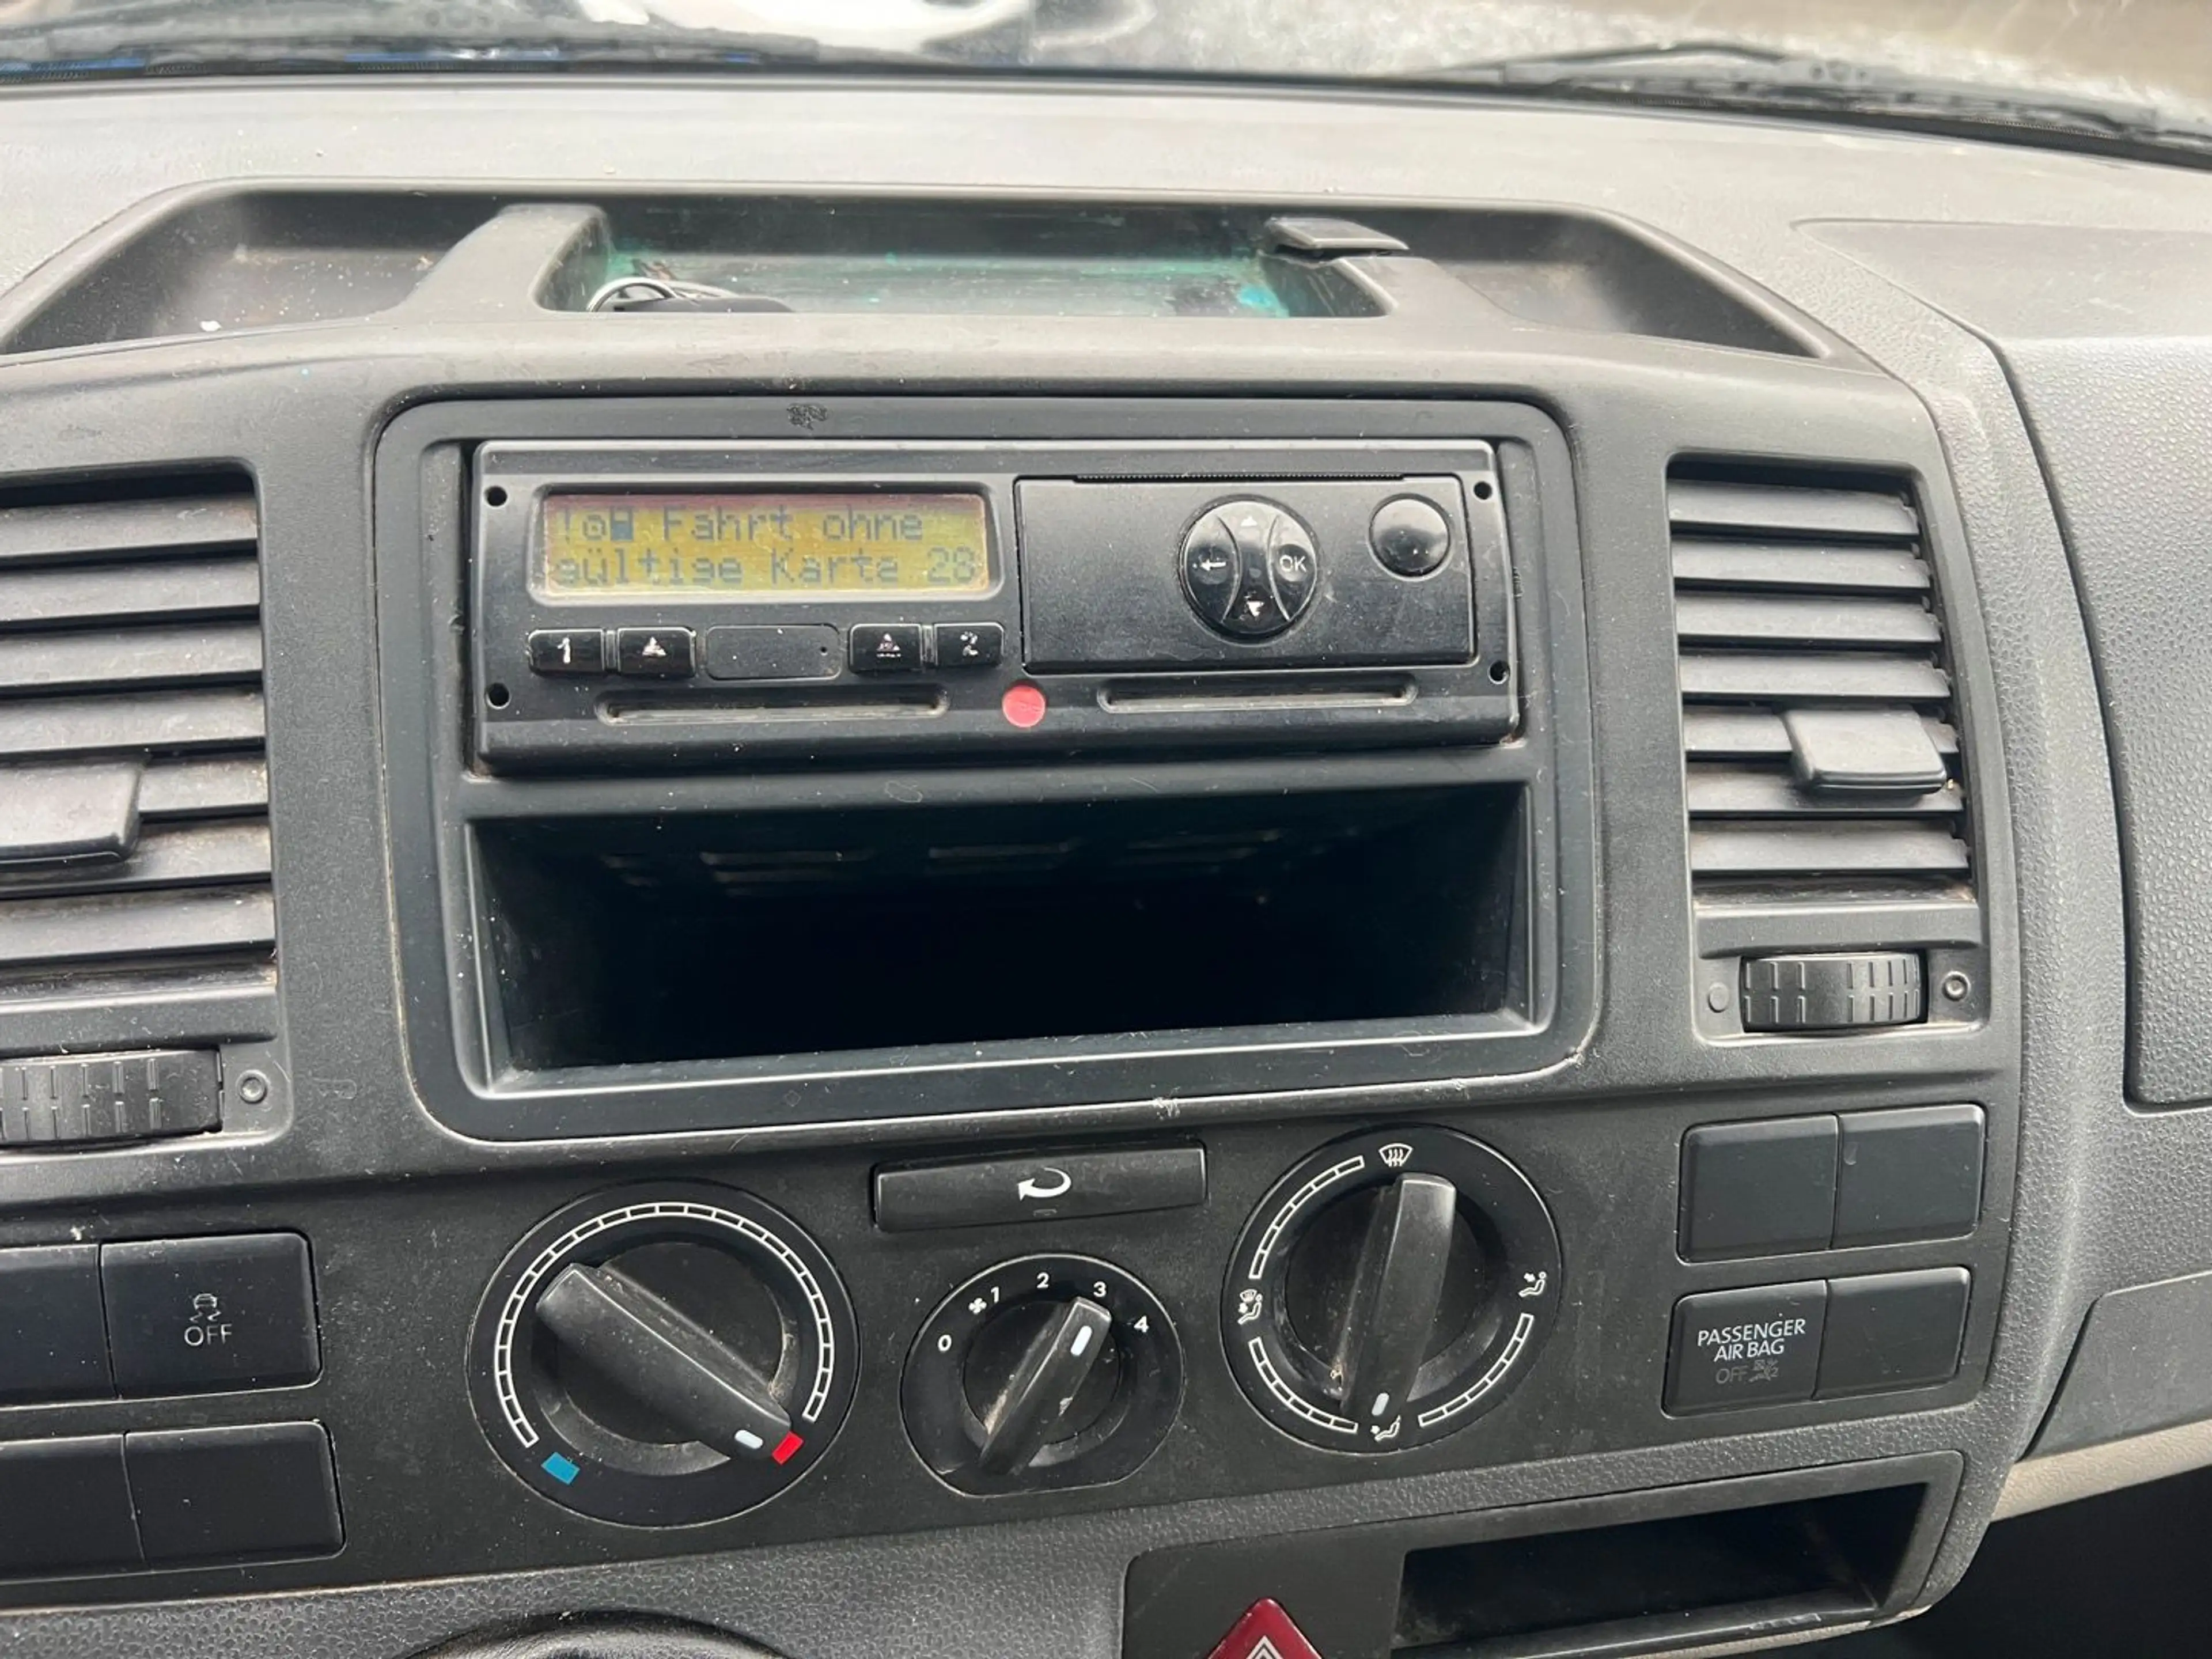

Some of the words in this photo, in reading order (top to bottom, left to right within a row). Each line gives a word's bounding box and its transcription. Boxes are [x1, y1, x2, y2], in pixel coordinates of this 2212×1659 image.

[662, 505, 793, 541] Fahrt
[823, 505, 923, 541] ohne
[771, 547, 899, 584] Karte
[926, 545, 976, 583] 28
[1279, 554, 1307, 573] OK
[557, 636, 571, 664] 1
[960, 631, 979, 657] 2
[937, 1334, 952, 1353] 0
[990, 1286, 1000, 1303] 1
[1036, 1272, 1050, 1289] 2
[1093, 1281, 1107, 1297] 3
[1134, 1315, 1150, 1333] 4
[184, 1323, 232, 1346] OFF
[1697, 1318, 1806, 1347] PASSENGER
[1713, 1343, 1743, 1362] AIR
[1746, 1338, 1785, 1358] BAG
[1715, 1365, 1749, 1384] OFF
